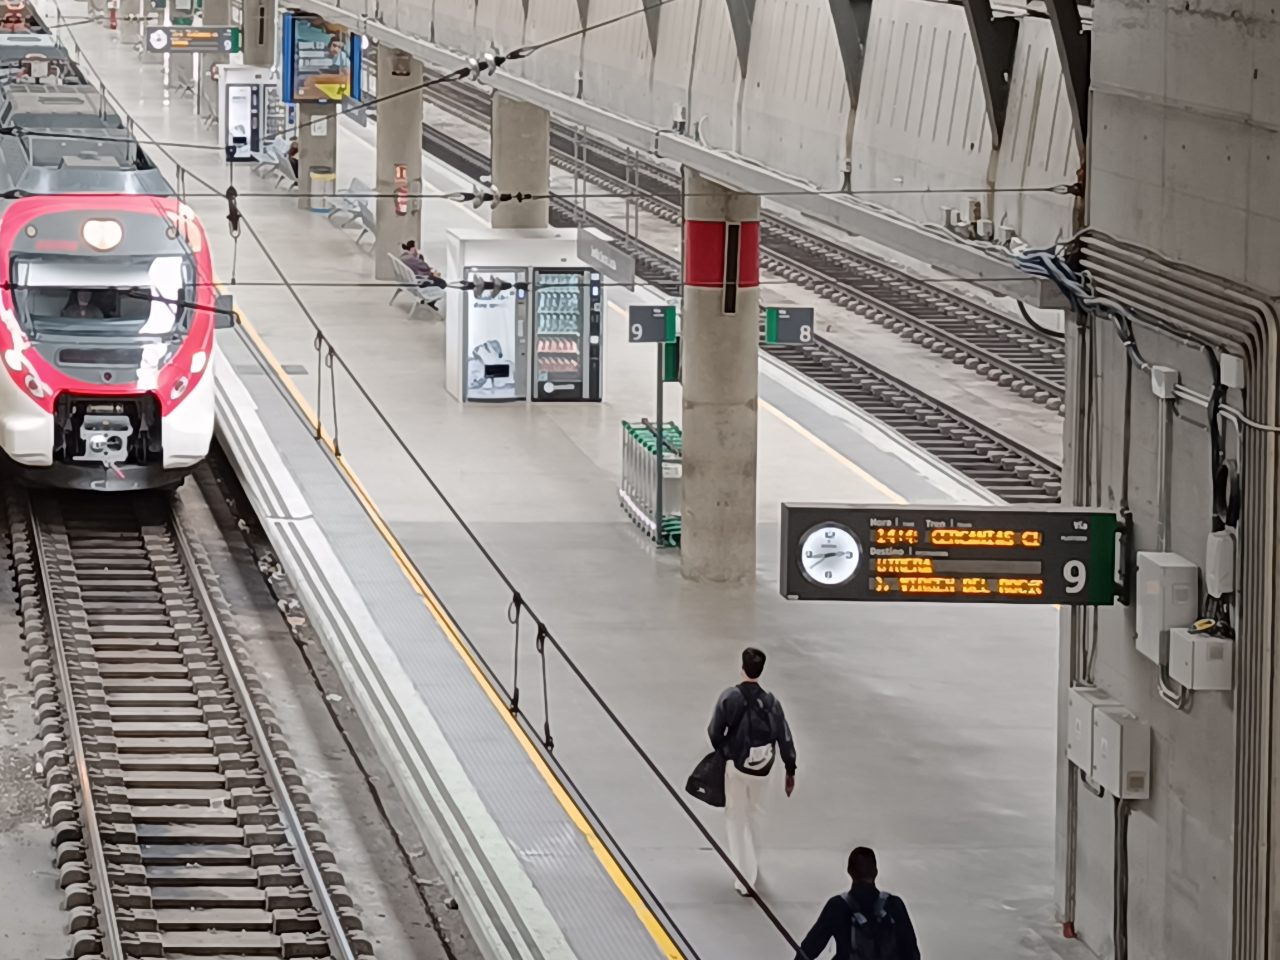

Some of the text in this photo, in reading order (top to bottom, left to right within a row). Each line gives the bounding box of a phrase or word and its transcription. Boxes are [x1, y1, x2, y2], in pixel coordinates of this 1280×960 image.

[631, 323, 643, 340] 9
[799, 325, 812, 342] 8
[1063, 560, 1086, 593] 9
